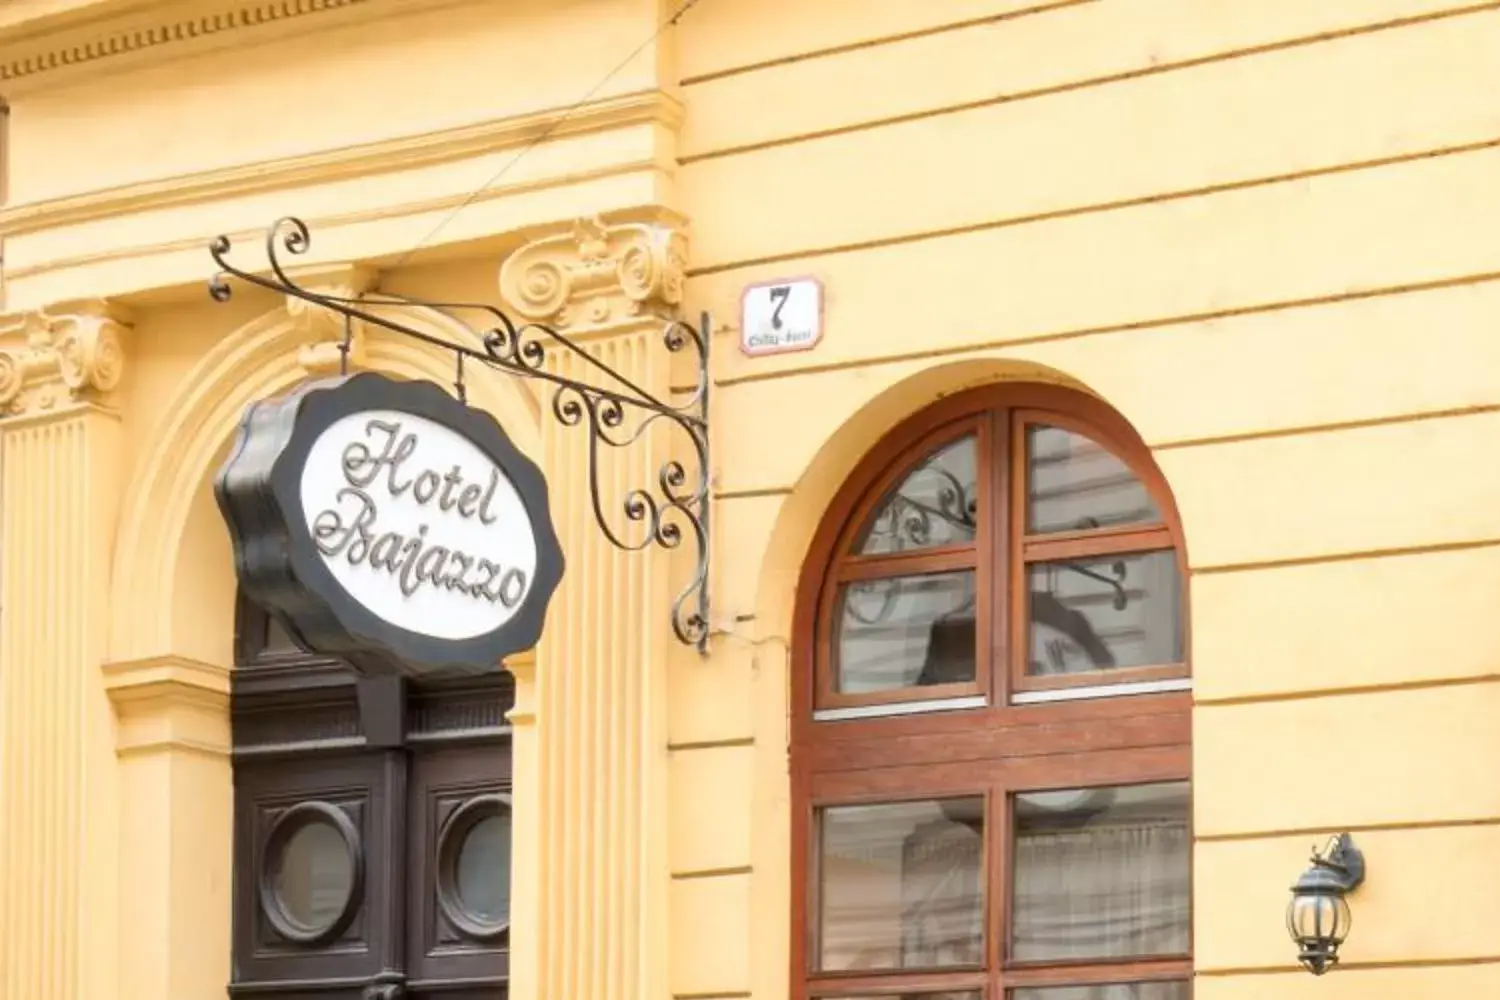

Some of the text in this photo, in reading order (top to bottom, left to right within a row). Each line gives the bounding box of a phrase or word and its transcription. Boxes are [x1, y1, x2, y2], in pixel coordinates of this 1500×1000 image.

[769, 285, 792, 330] 7
[341, 419, 499, 525] Hotel
[312, 487, 528, 609] Bajazzo
